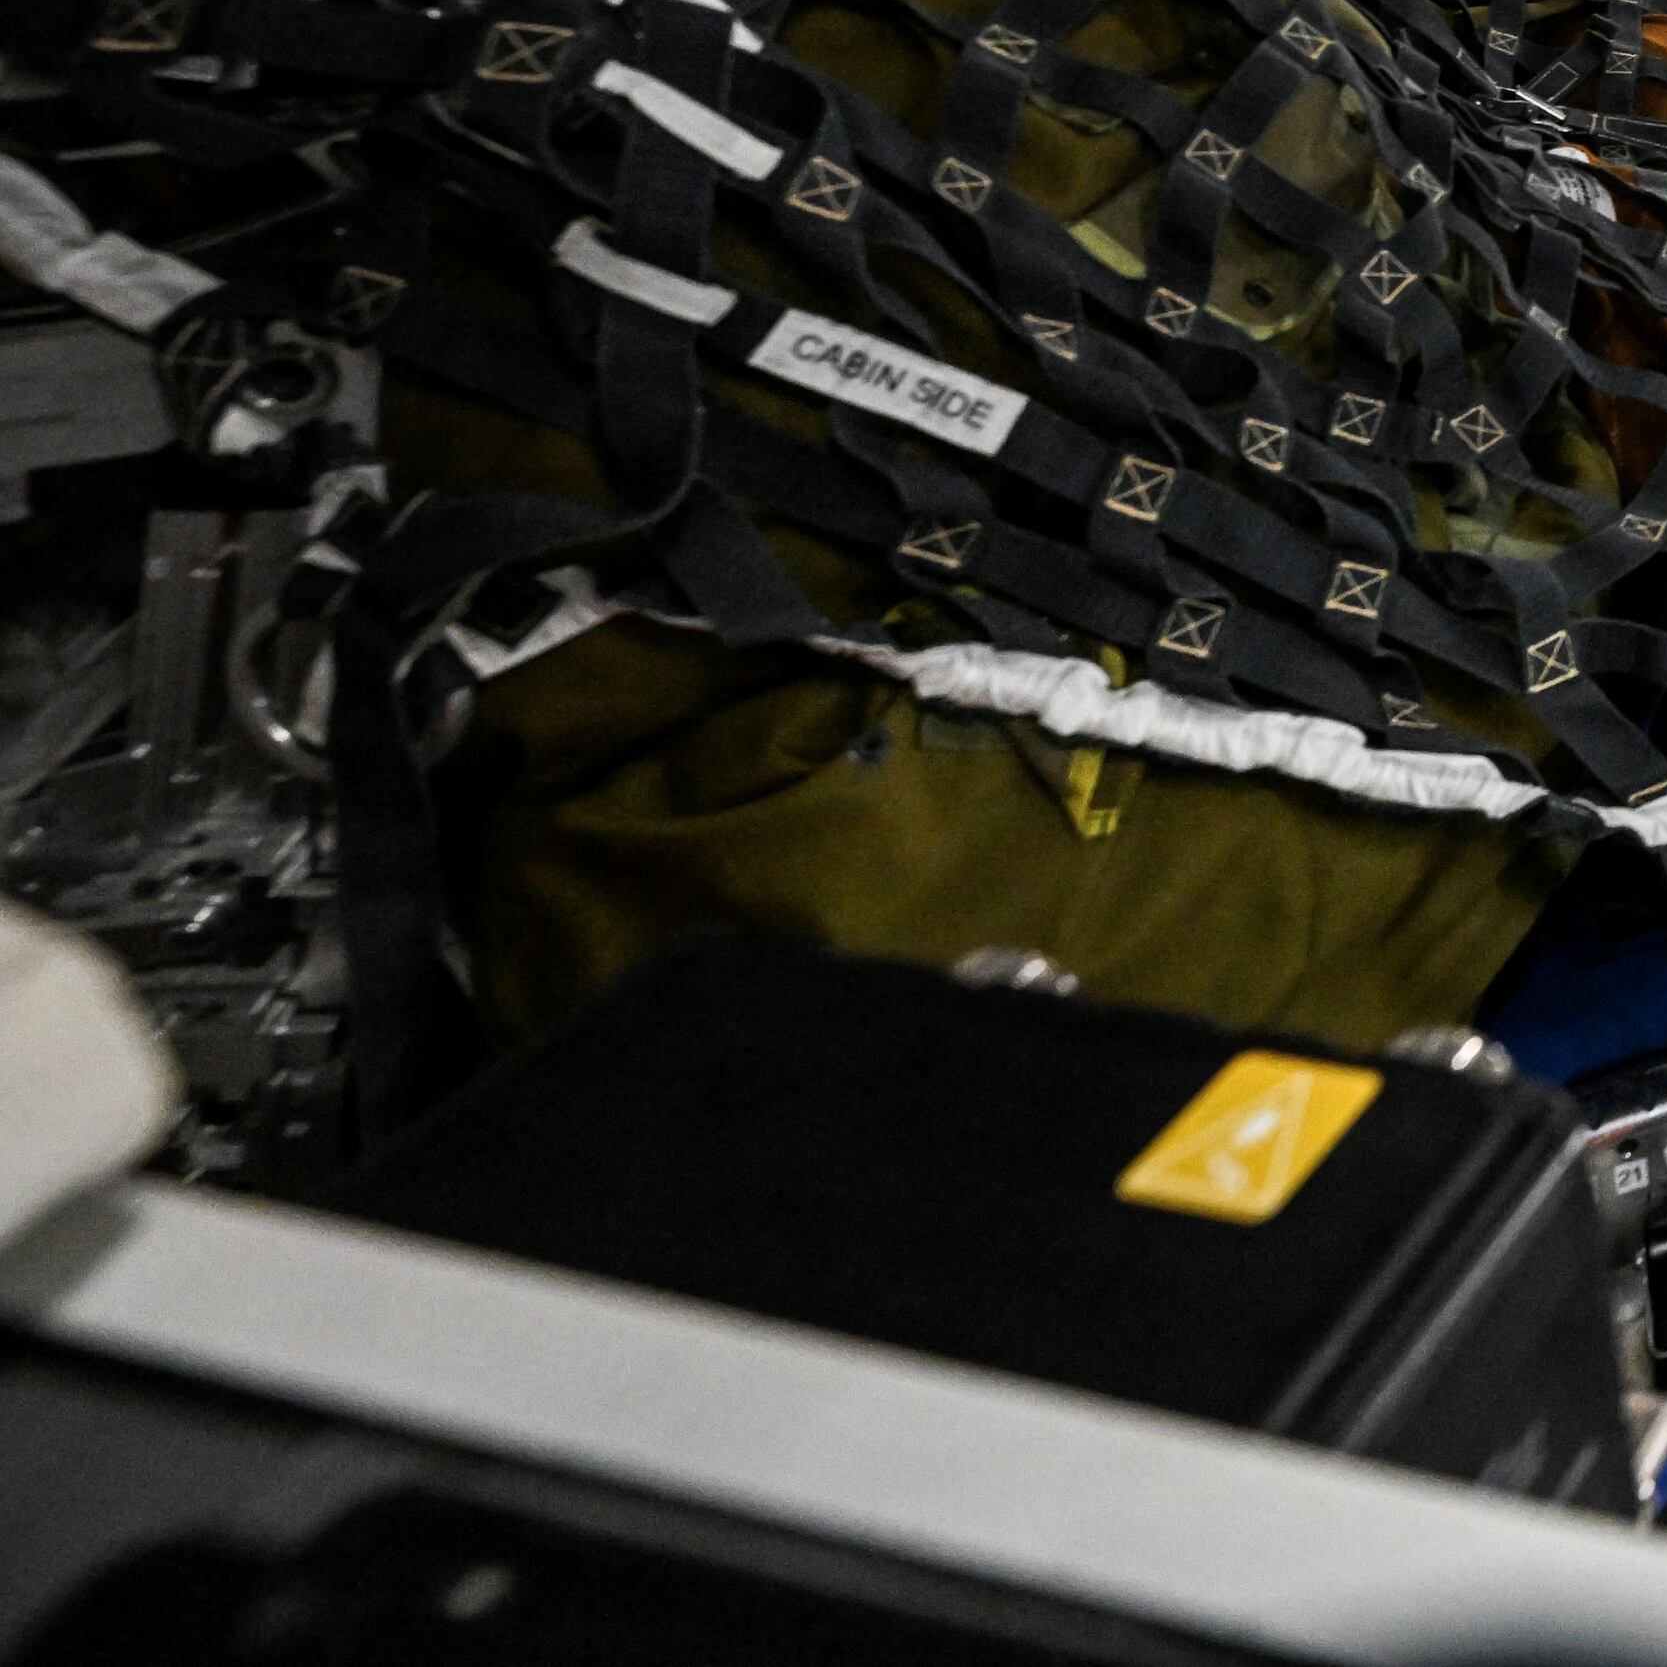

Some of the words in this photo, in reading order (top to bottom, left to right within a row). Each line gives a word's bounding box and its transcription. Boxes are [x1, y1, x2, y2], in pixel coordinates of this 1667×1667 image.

[790, 334, 908, 393] CABIN
[909, 376, 994, 431] SIDE
[1618, 1166, 1642, 1185] 21
